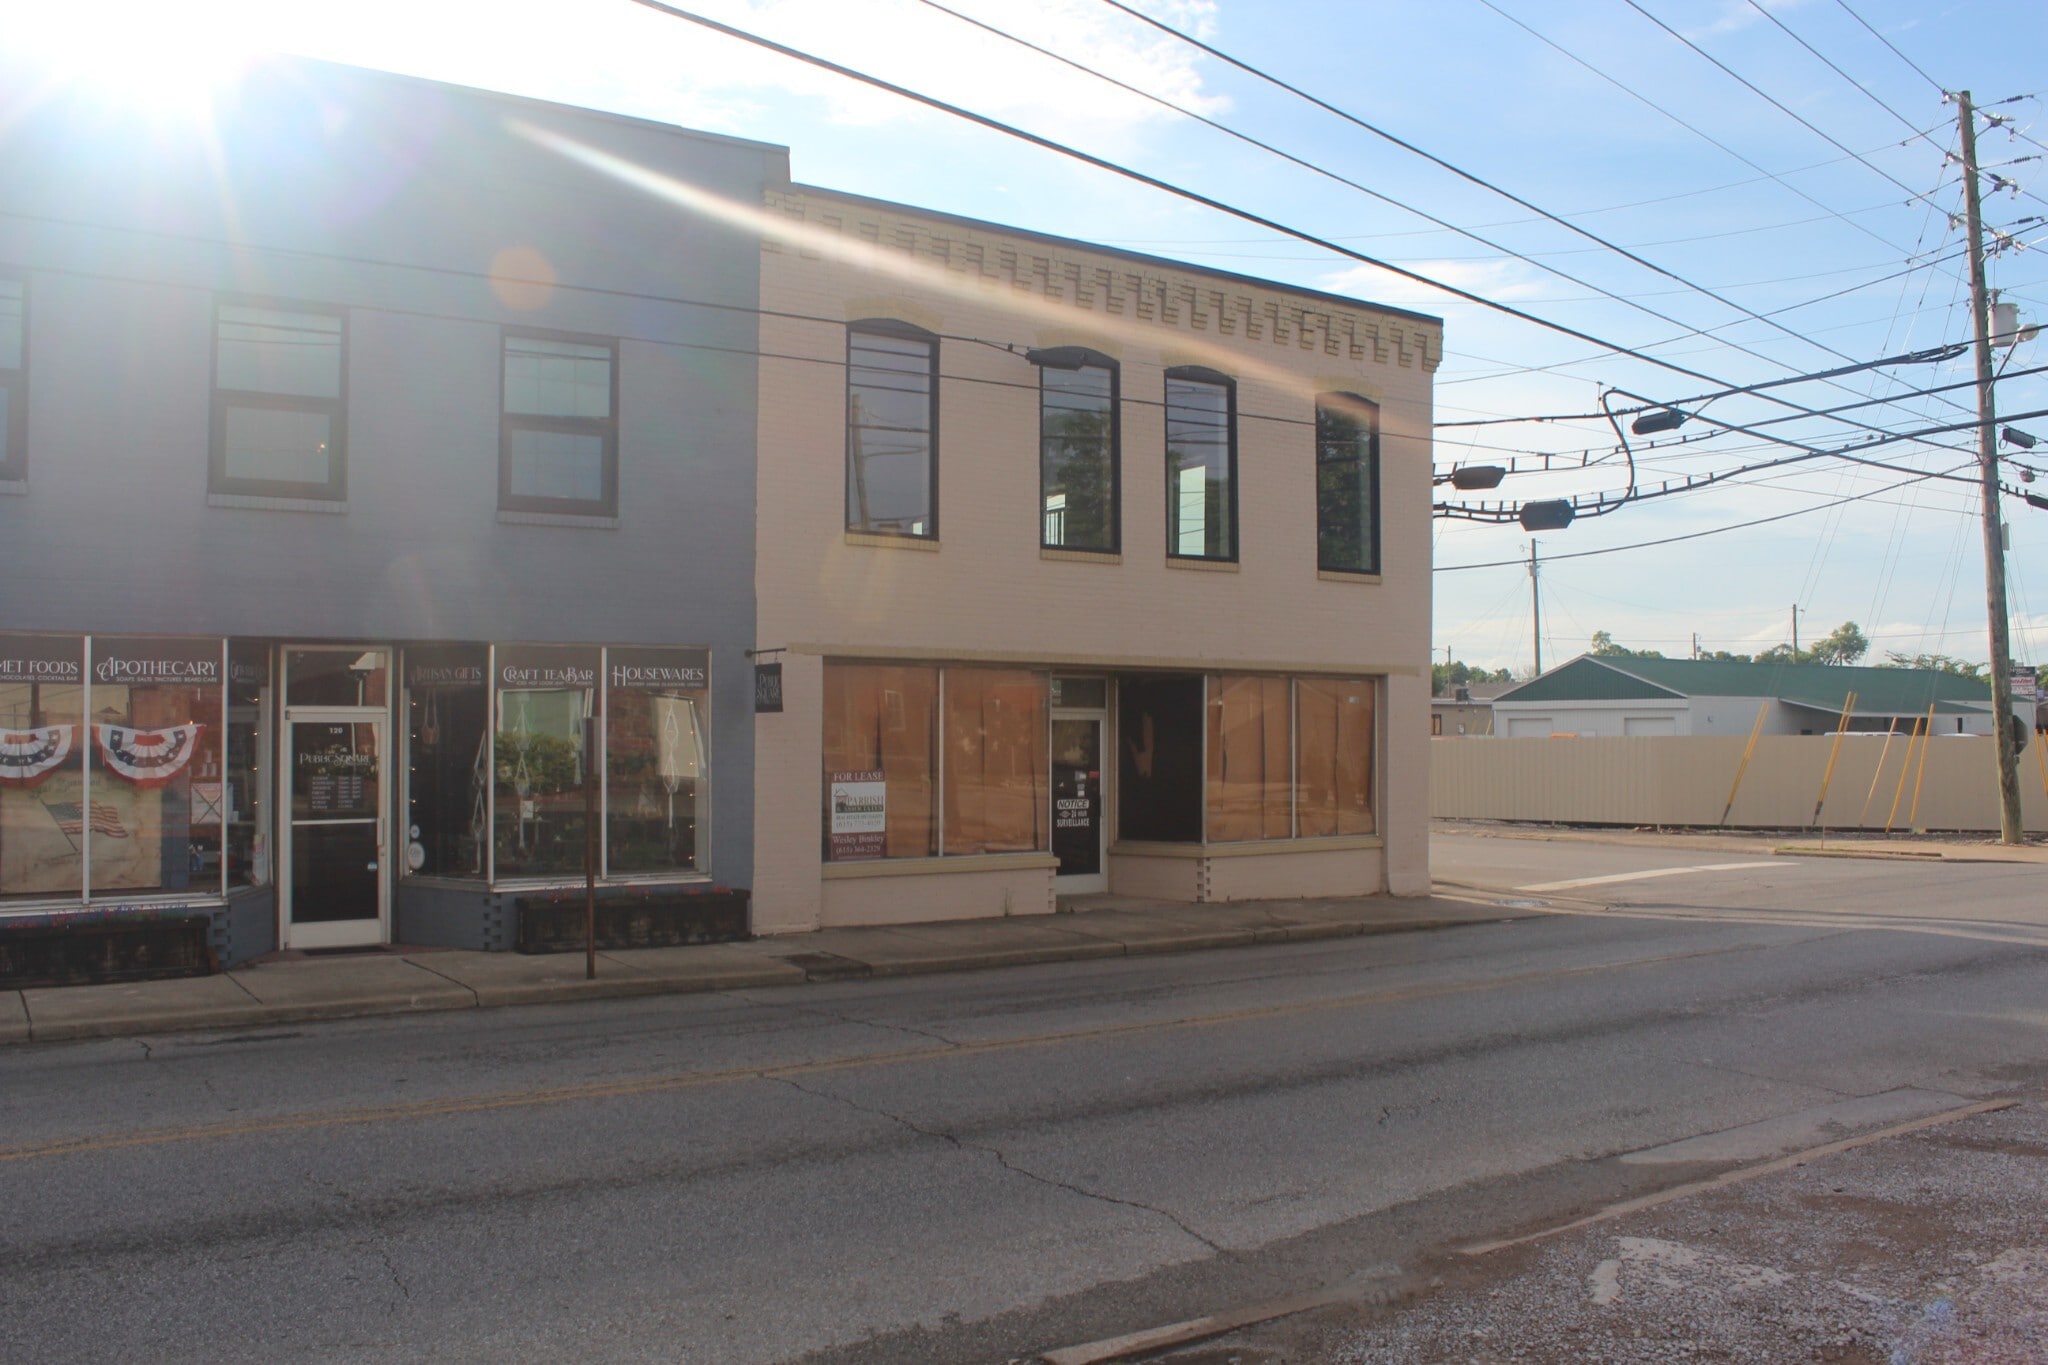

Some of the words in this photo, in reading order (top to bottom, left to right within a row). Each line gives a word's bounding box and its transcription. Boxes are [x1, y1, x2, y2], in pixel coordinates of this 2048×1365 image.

[29, 660, 79, 674] FOODS
[96, 656, 218, 681] APOTHECARY
[455, 667, 482, 680] GIFTS
[503, 666, 539, 682] CRAFT
[544, 669, 565, 680] TEA
[565, 666, 594, 684] BAR
[611, 665, 704, 687] HOUSEWARES
[299, 753, 333, 765] PUBLIC
[833, 772, 852, 782] FOR
[854, 771, 884, 781] LEASE
[1058, 800, 1088, 808] NOTICE
[1056, 818, 1090, 827] SURVEILLANCE
